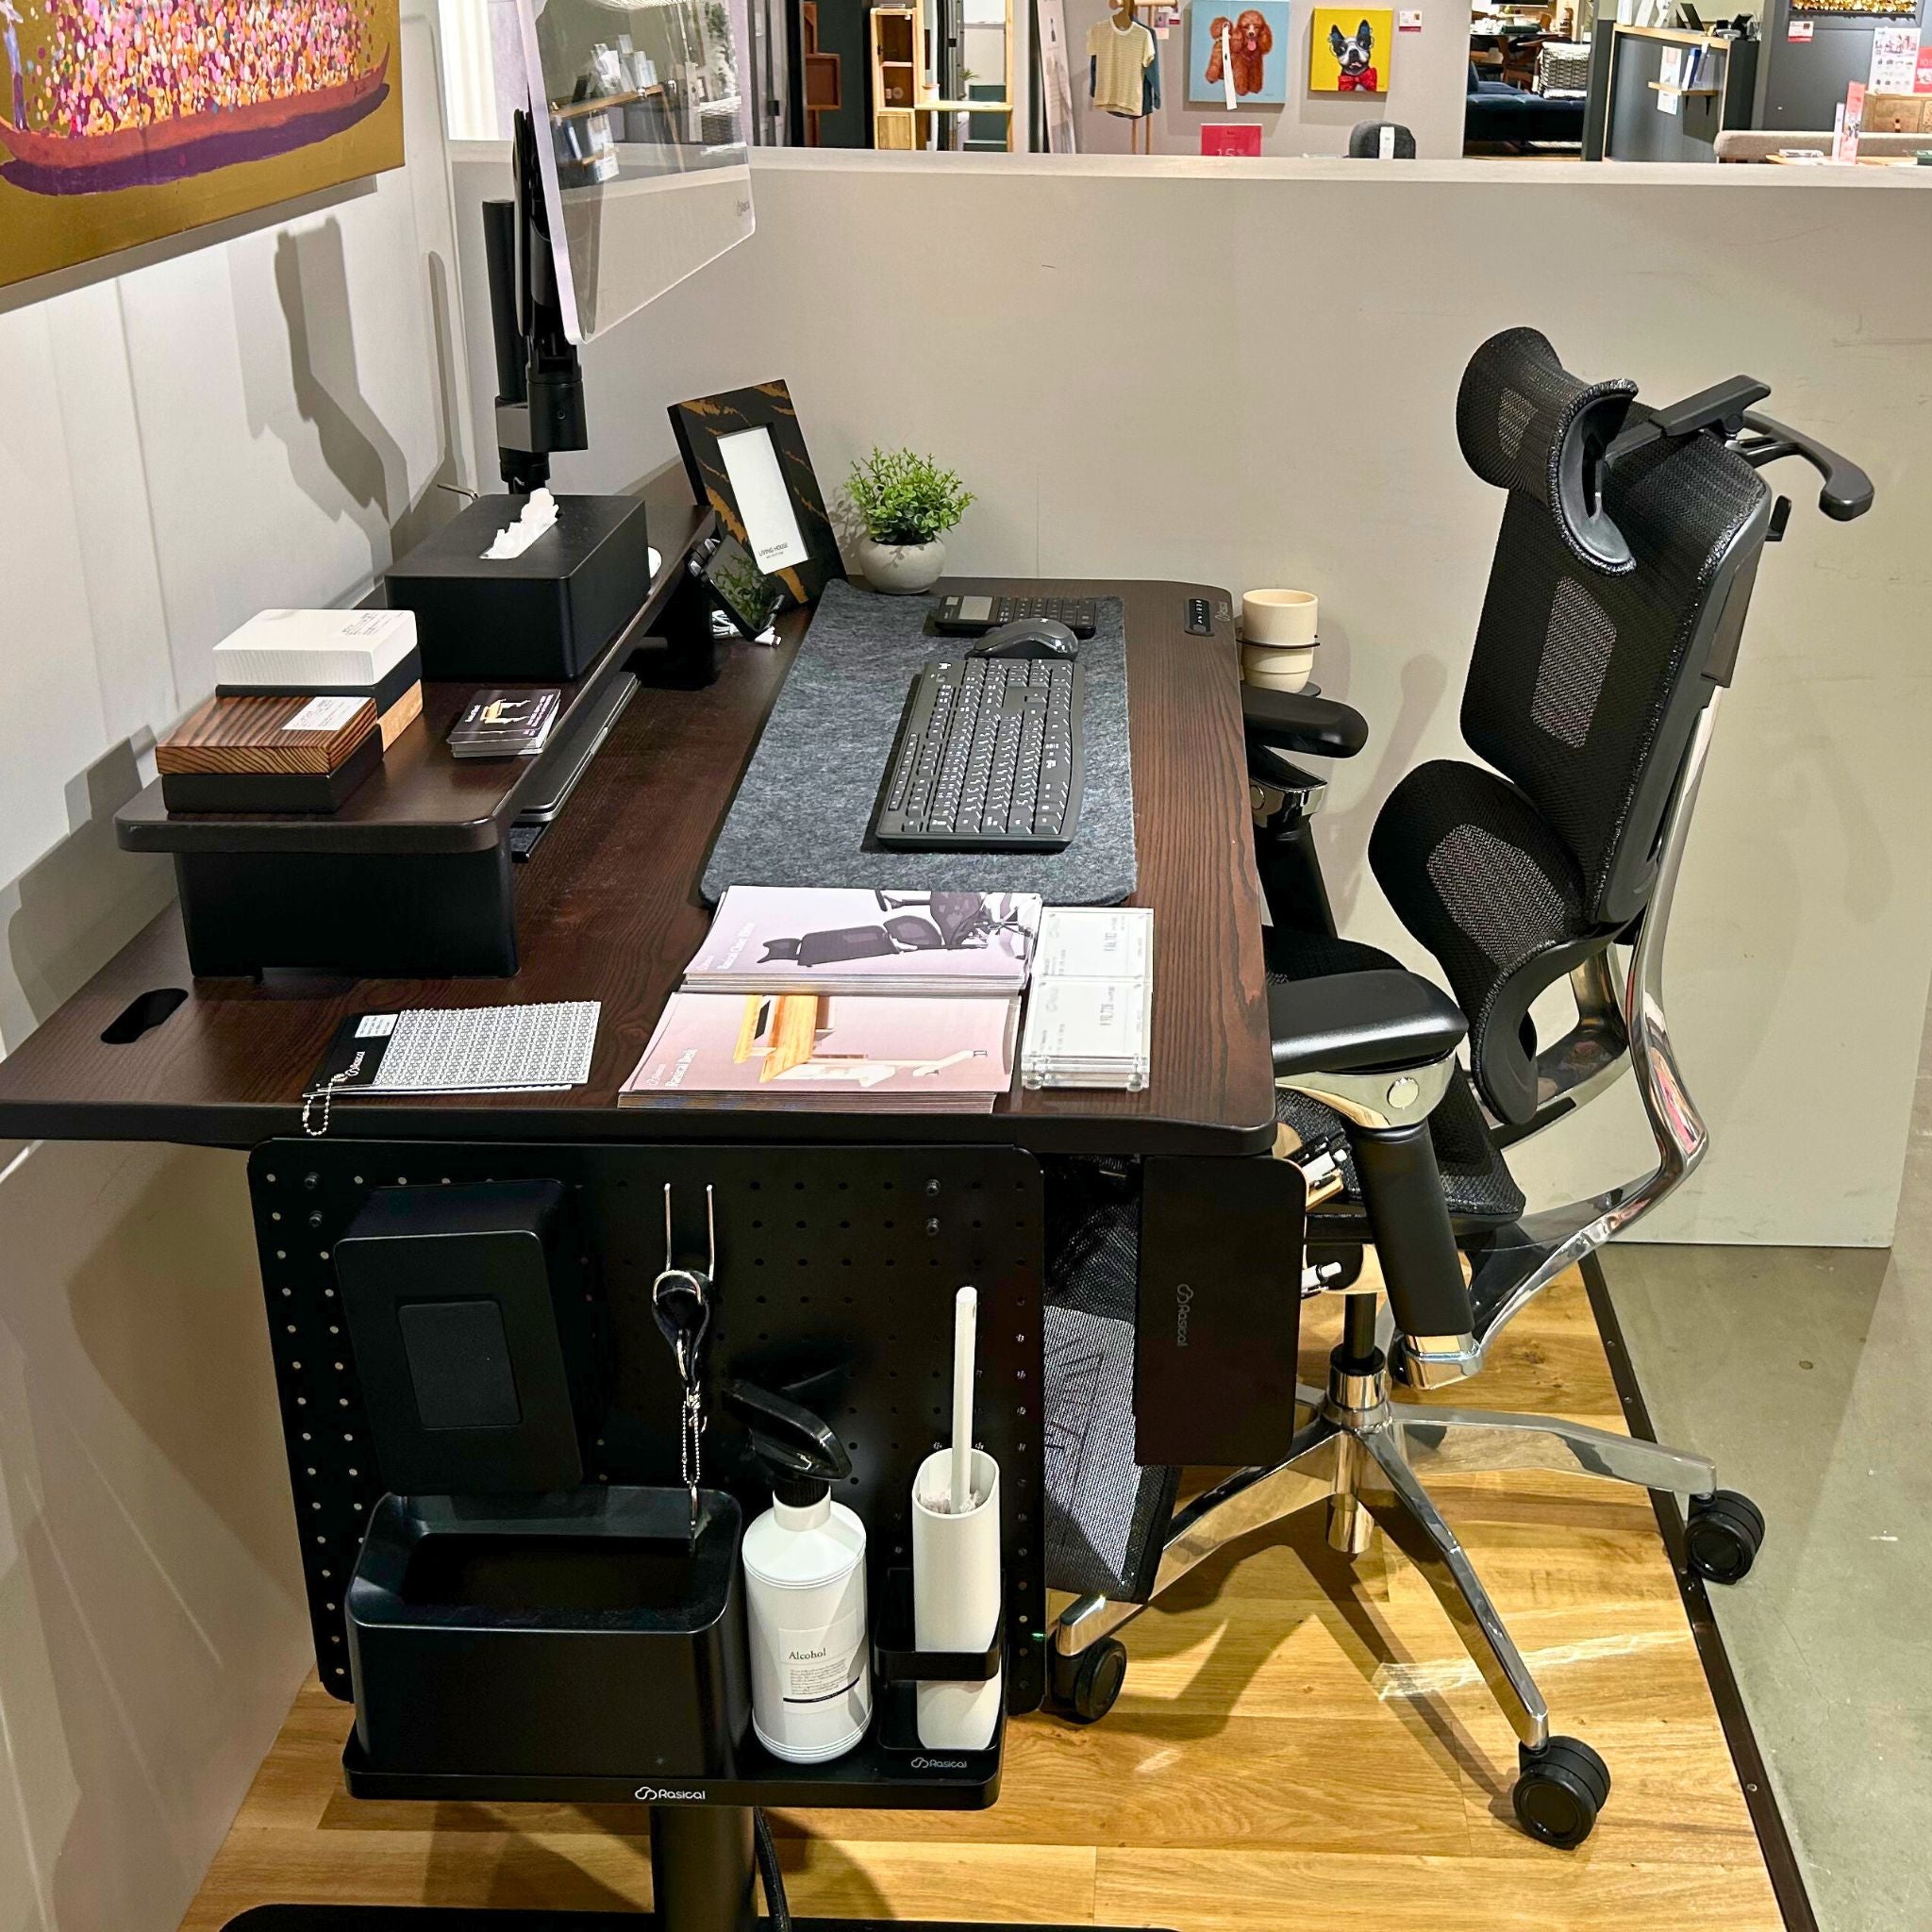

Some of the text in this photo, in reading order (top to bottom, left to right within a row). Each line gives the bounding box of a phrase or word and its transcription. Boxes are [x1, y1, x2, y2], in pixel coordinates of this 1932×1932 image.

[789, 1647, 826, 1660] Alcohol
[929, 1758, 968, 1769] Rasical
[658, 1789, 706, 1800] Rasical
